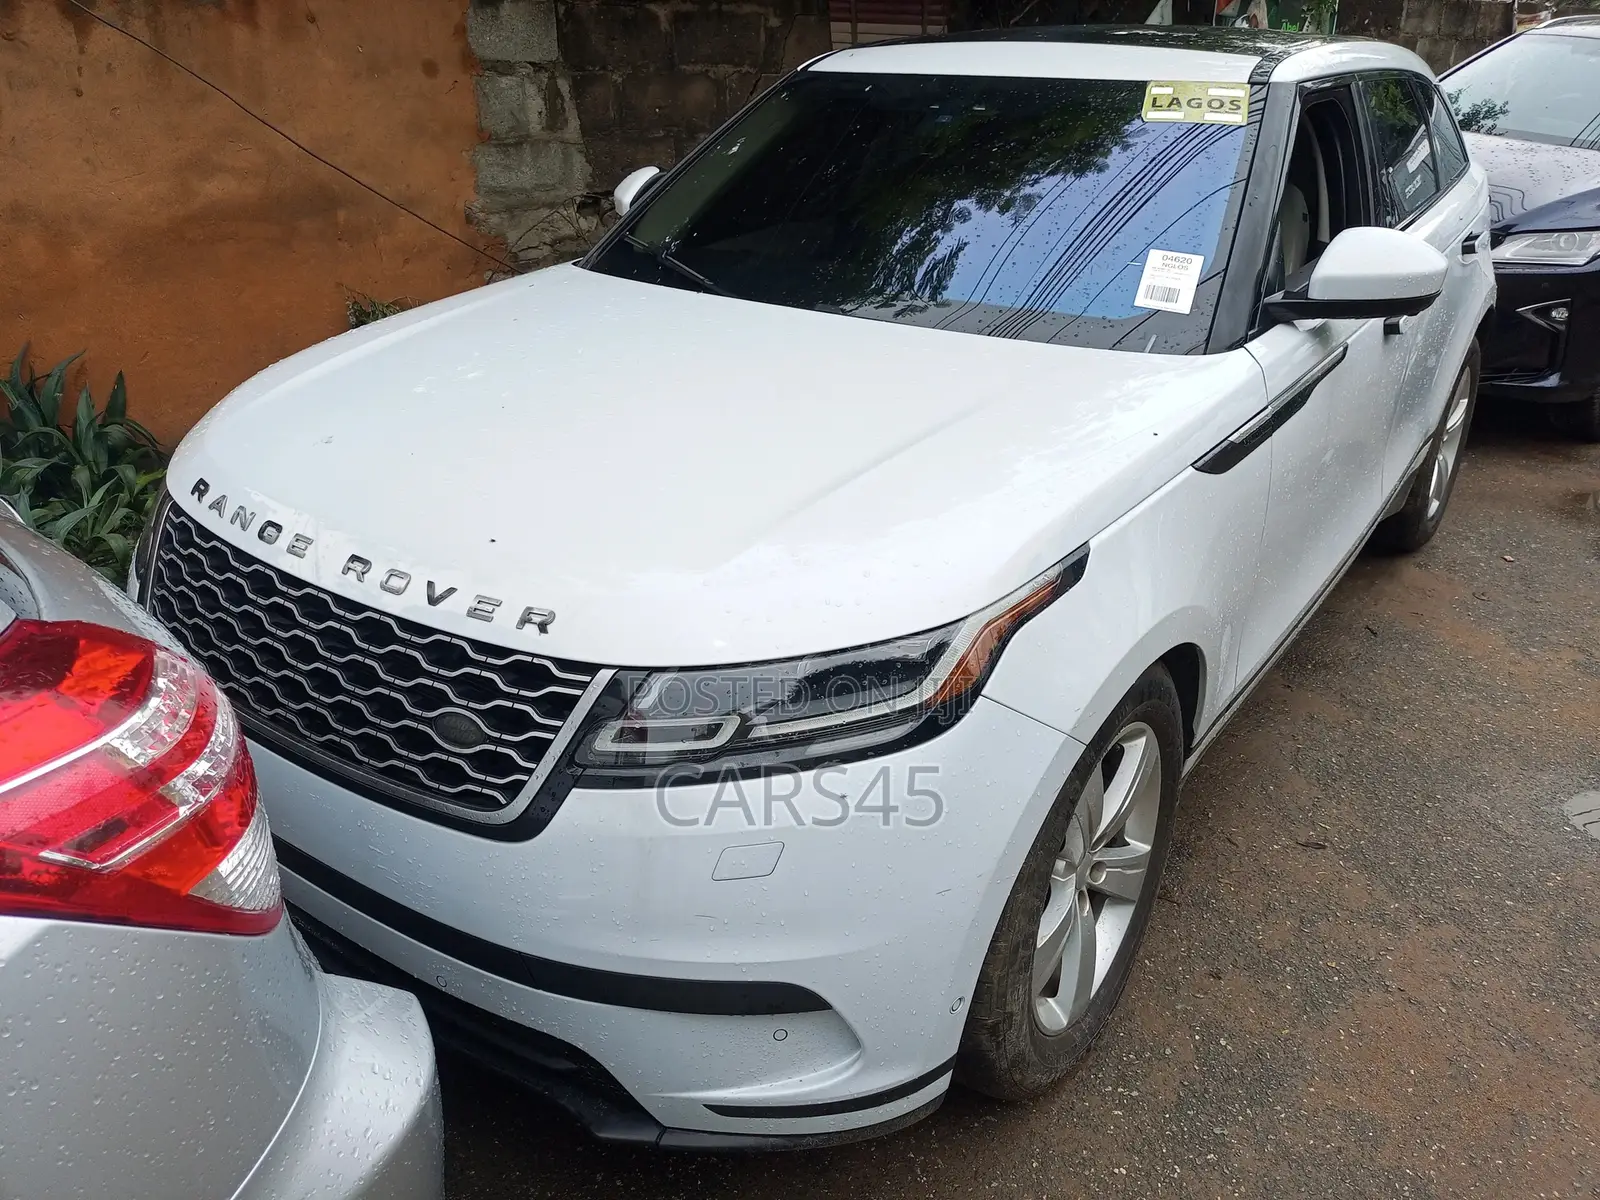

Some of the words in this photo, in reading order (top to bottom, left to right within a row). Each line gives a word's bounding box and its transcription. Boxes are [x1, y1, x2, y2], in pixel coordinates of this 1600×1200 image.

[1151, 97, 1242, 111] LAGOS
[1161, 254, 1193, 264] 04620
[1161, 262, 1189, 271] NGLOS
[190, 477, 314, 559] RANGE
[341, 553, 556, 635] ROVER
